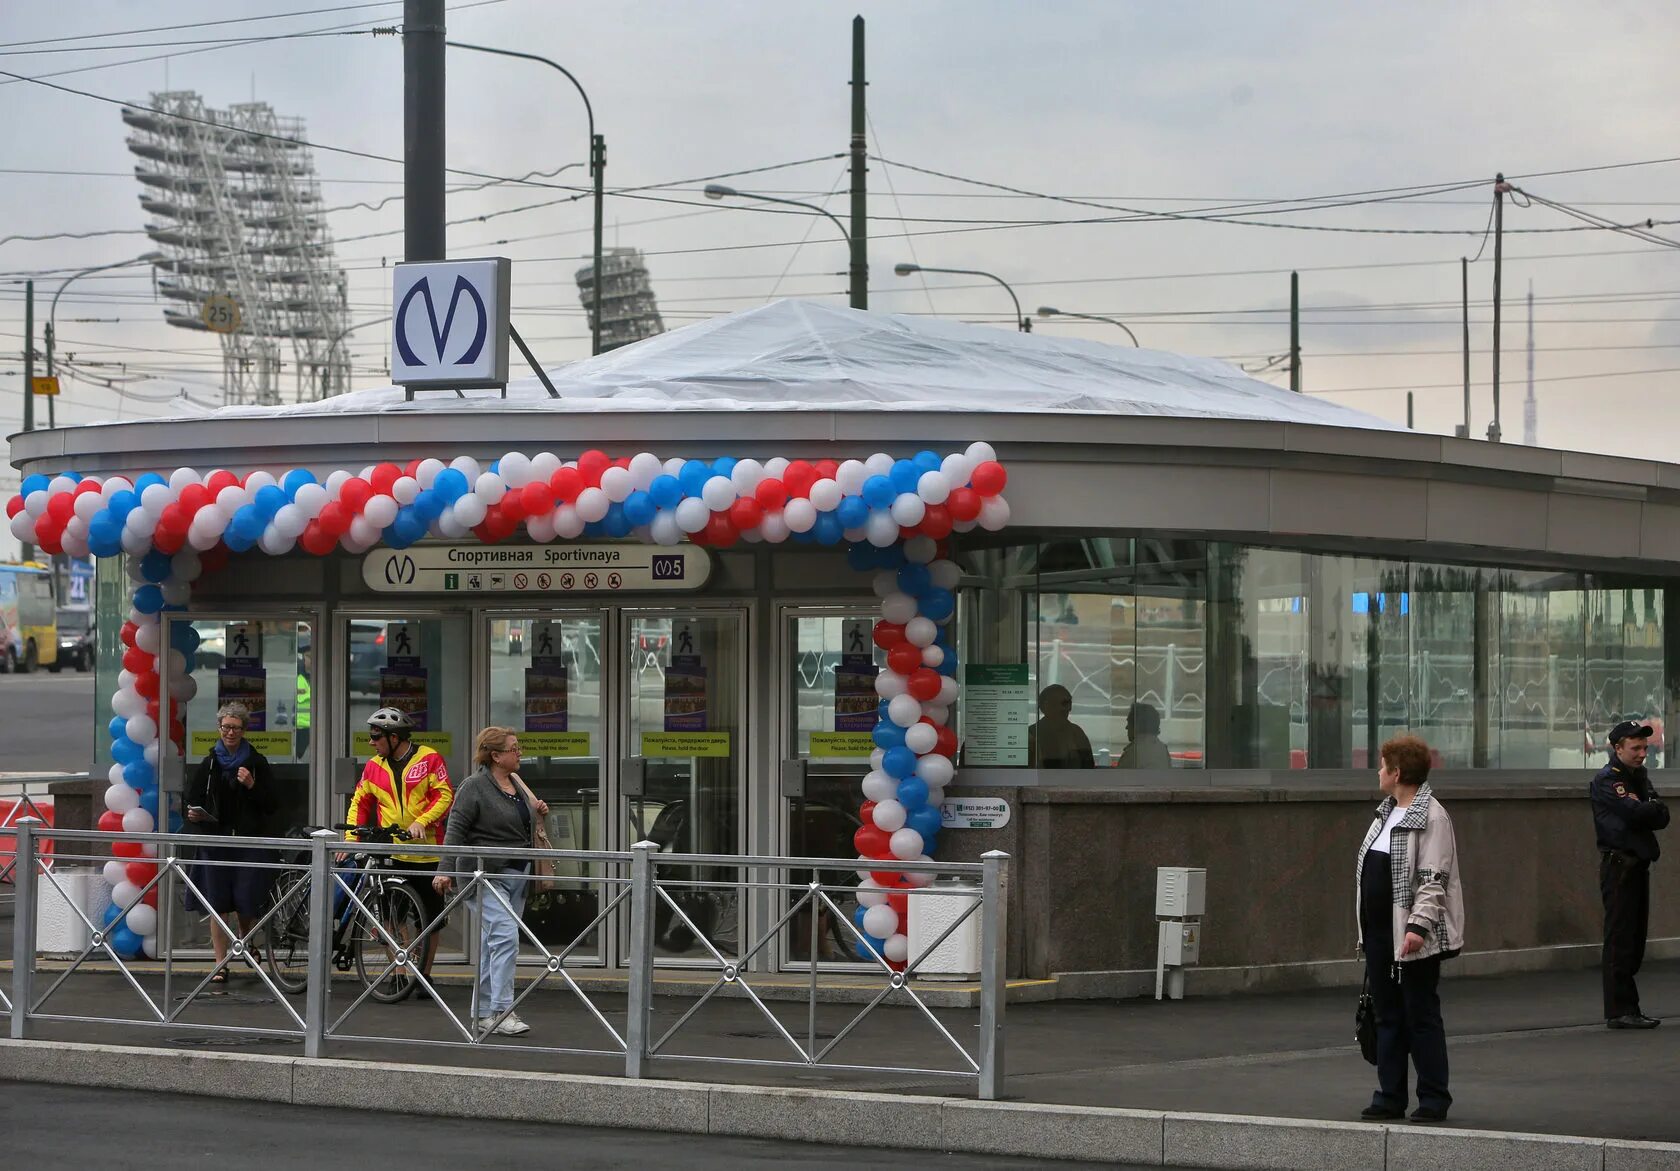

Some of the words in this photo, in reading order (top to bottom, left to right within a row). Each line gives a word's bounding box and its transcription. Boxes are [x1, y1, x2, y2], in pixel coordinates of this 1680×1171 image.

[448, 549, 533, 565] Спортивная
[545, 549, 620, 564] Sportivnaya
[673, 559, 682, 576] 5
